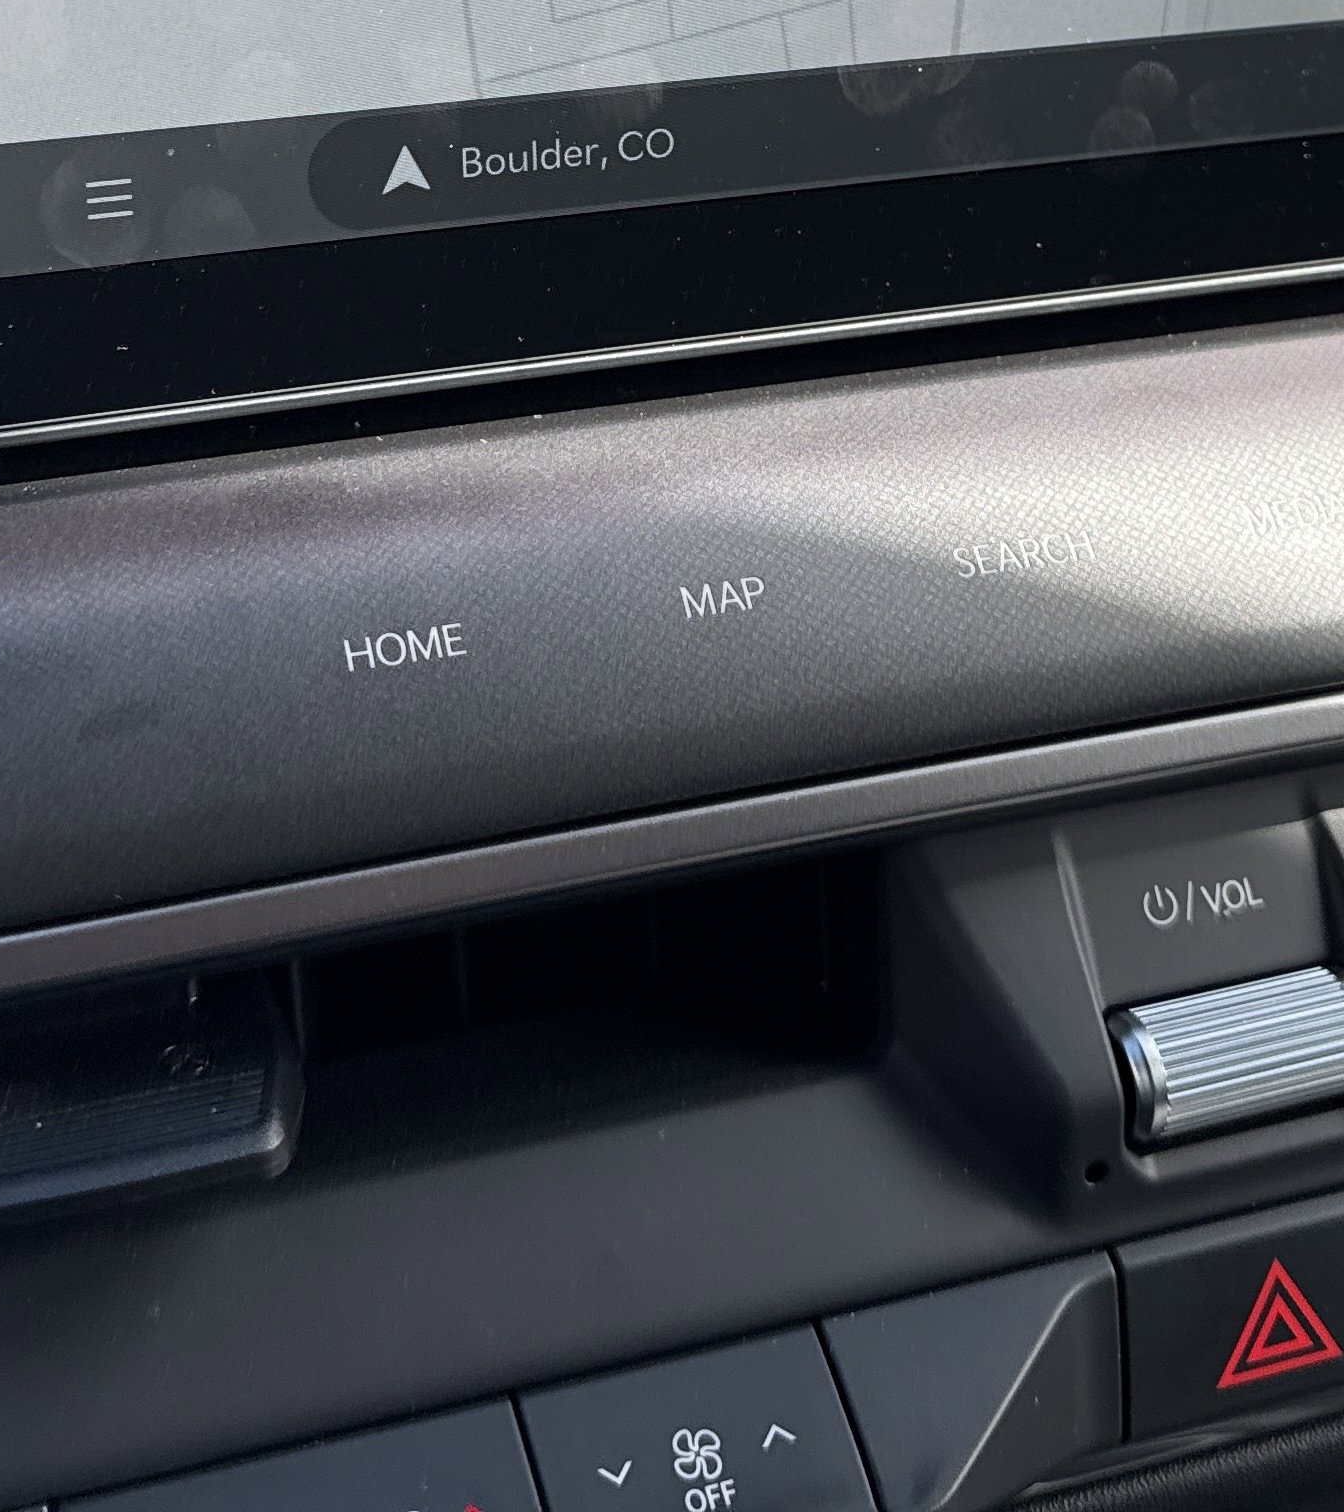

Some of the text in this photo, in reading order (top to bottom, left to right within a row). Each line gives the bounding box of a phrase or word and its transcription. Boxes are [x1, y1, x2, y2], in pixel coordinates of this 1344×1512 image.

[462, 128, 675, 178] Boulder, CO
[953, 530, 1097, 580] SEARCH
[679, 576, 765, 619] MAP
[343, 623, 468, 672] HOME
[684, 1478, 736, 1512] OFF
